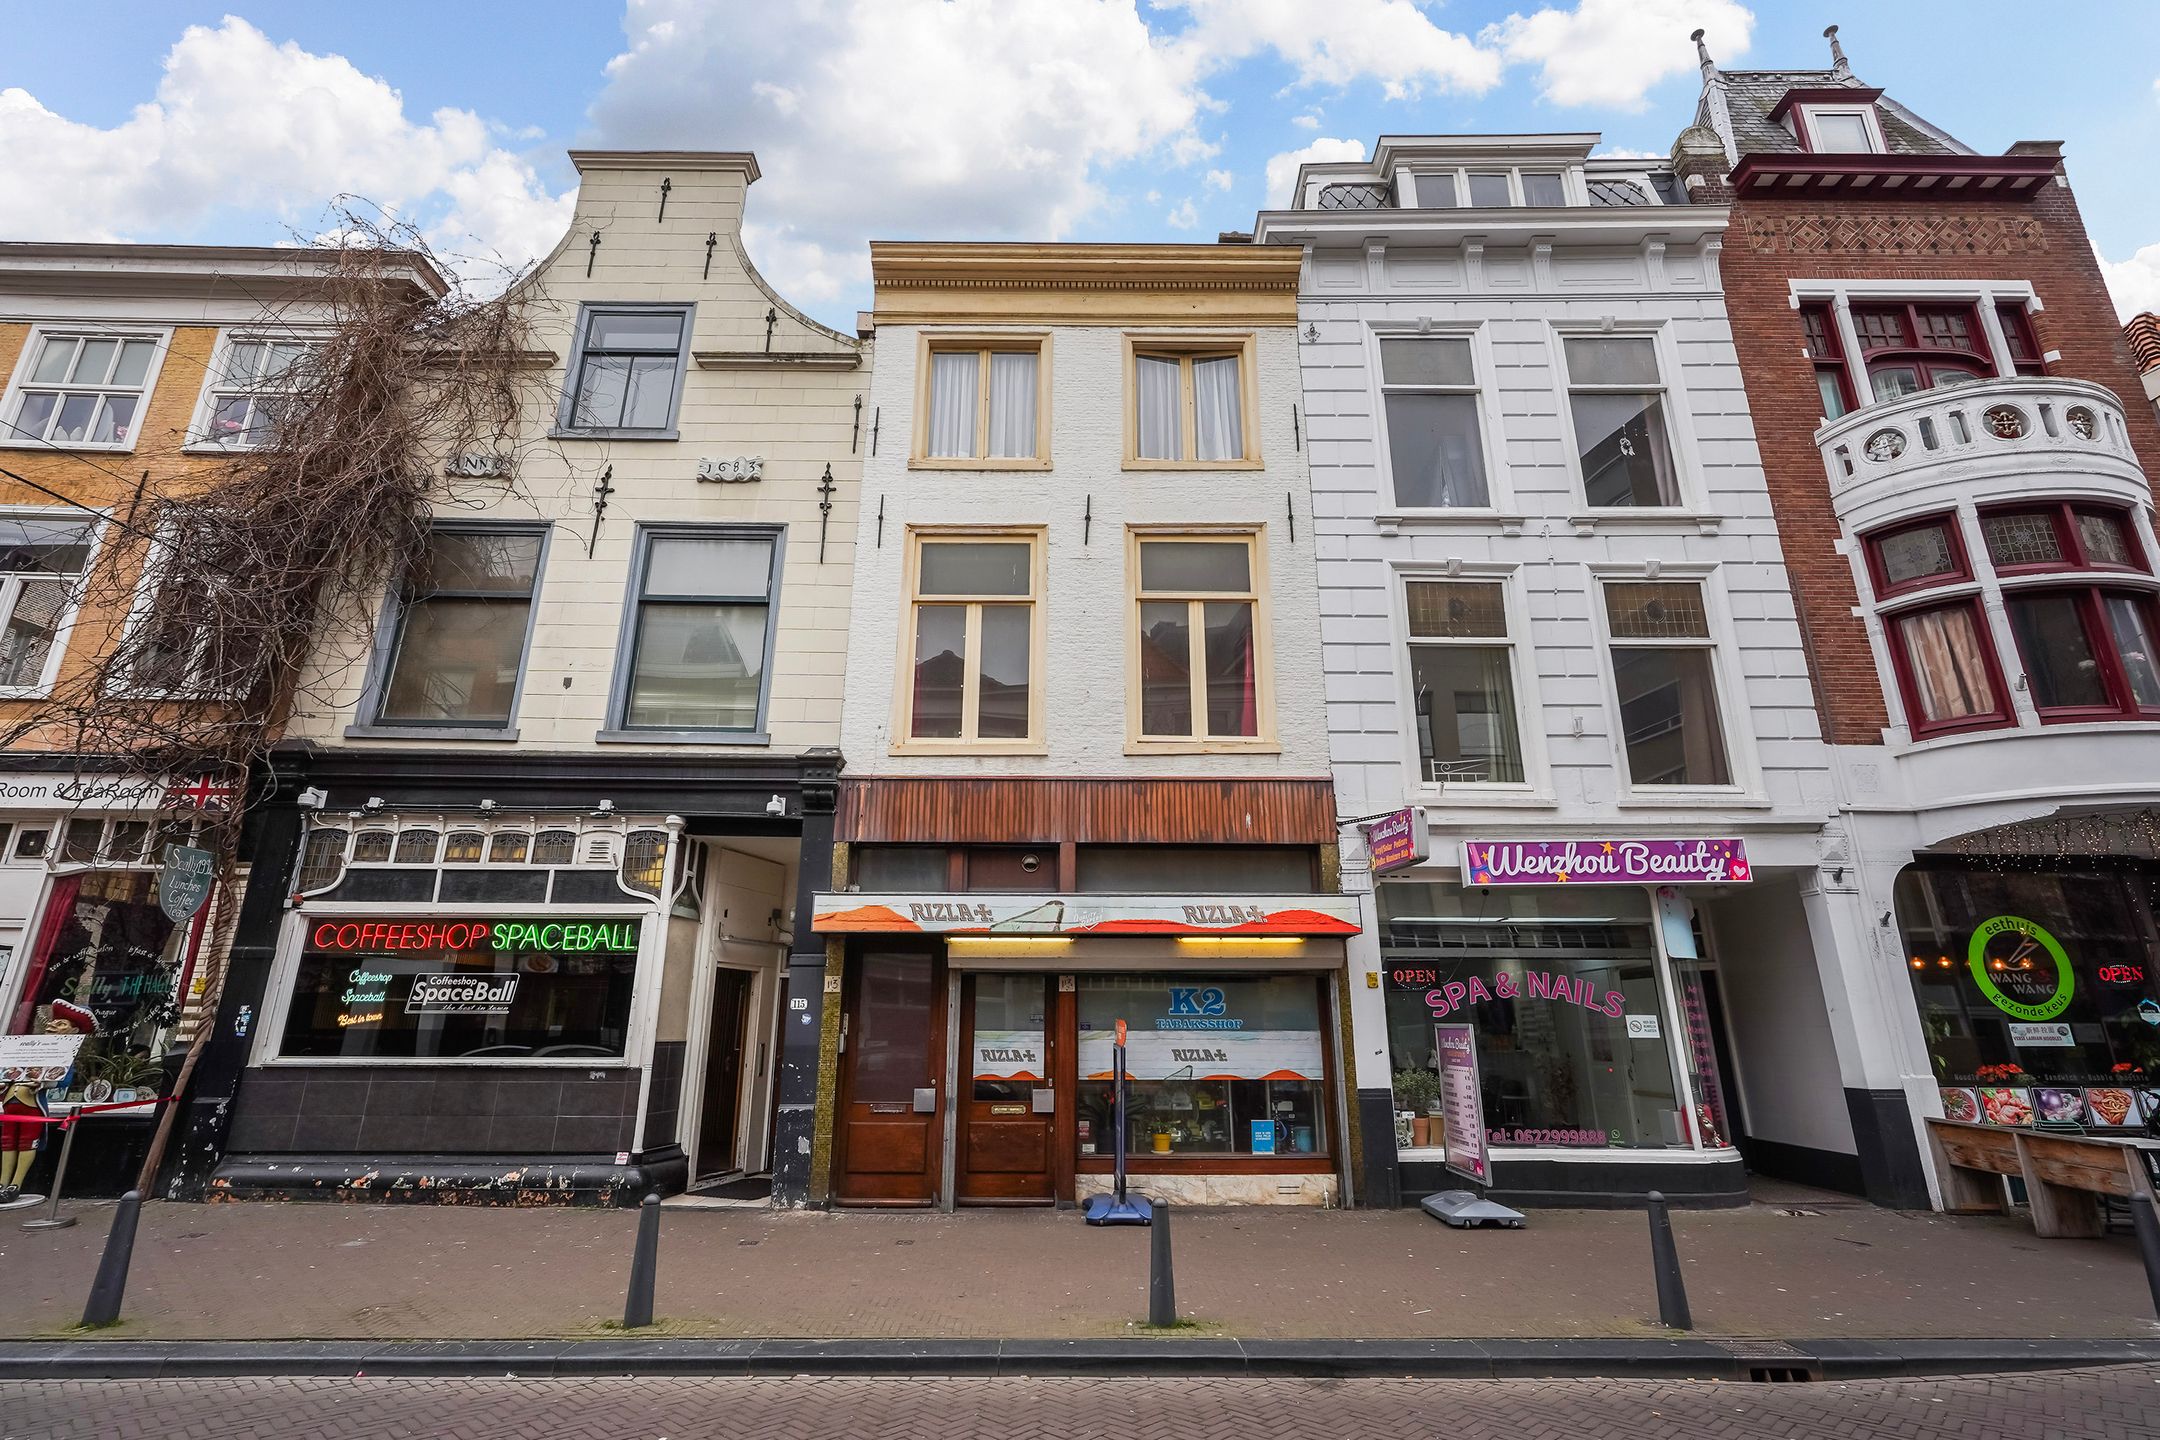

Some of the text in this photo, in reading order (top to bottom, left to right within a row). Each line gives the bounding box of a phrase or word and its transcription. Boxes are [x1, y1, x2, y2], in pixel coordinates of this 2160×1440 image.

[706, 461, 757, 474] 1683
[1487, 840, 1727, 882] Wenzhou Beauty
[168, 874, 202, 893] Lunches
[168, 888, 196, 910] Coffee
[168, 904, 187, 918] Teas
[1984, 917, 2038, 936] eethuis
[314, 923, 637, 951] COFFEESHOP SPACEBALL
[348, 969, 394, 985] Coffeeshop
[430, 975, 478, 988] Coffeeshop
[1393, 969, 1437, 983] OPEN
[1989, 972, 2033, 984] WANG
[2098, 966, 2144, 981] OPEN
[341, 988, 386, 1005] Spaceball
[411, 980, 516, 1006] SpaceBall
[1424, 975, 1492, 1018] SPA
[1495, 971, 1522, 998] &
[1527, 970, 1627, 1019] NAILS
[2012, 983, 2056, 995] WANG
[792, 999, 806, 1009] 115
[1168, 986, 1227, 1016] K2
[1155, 1018, 1244, 1030] TABAKSSHOP
[1513, 1128, 1608, 1145] 0622999888
